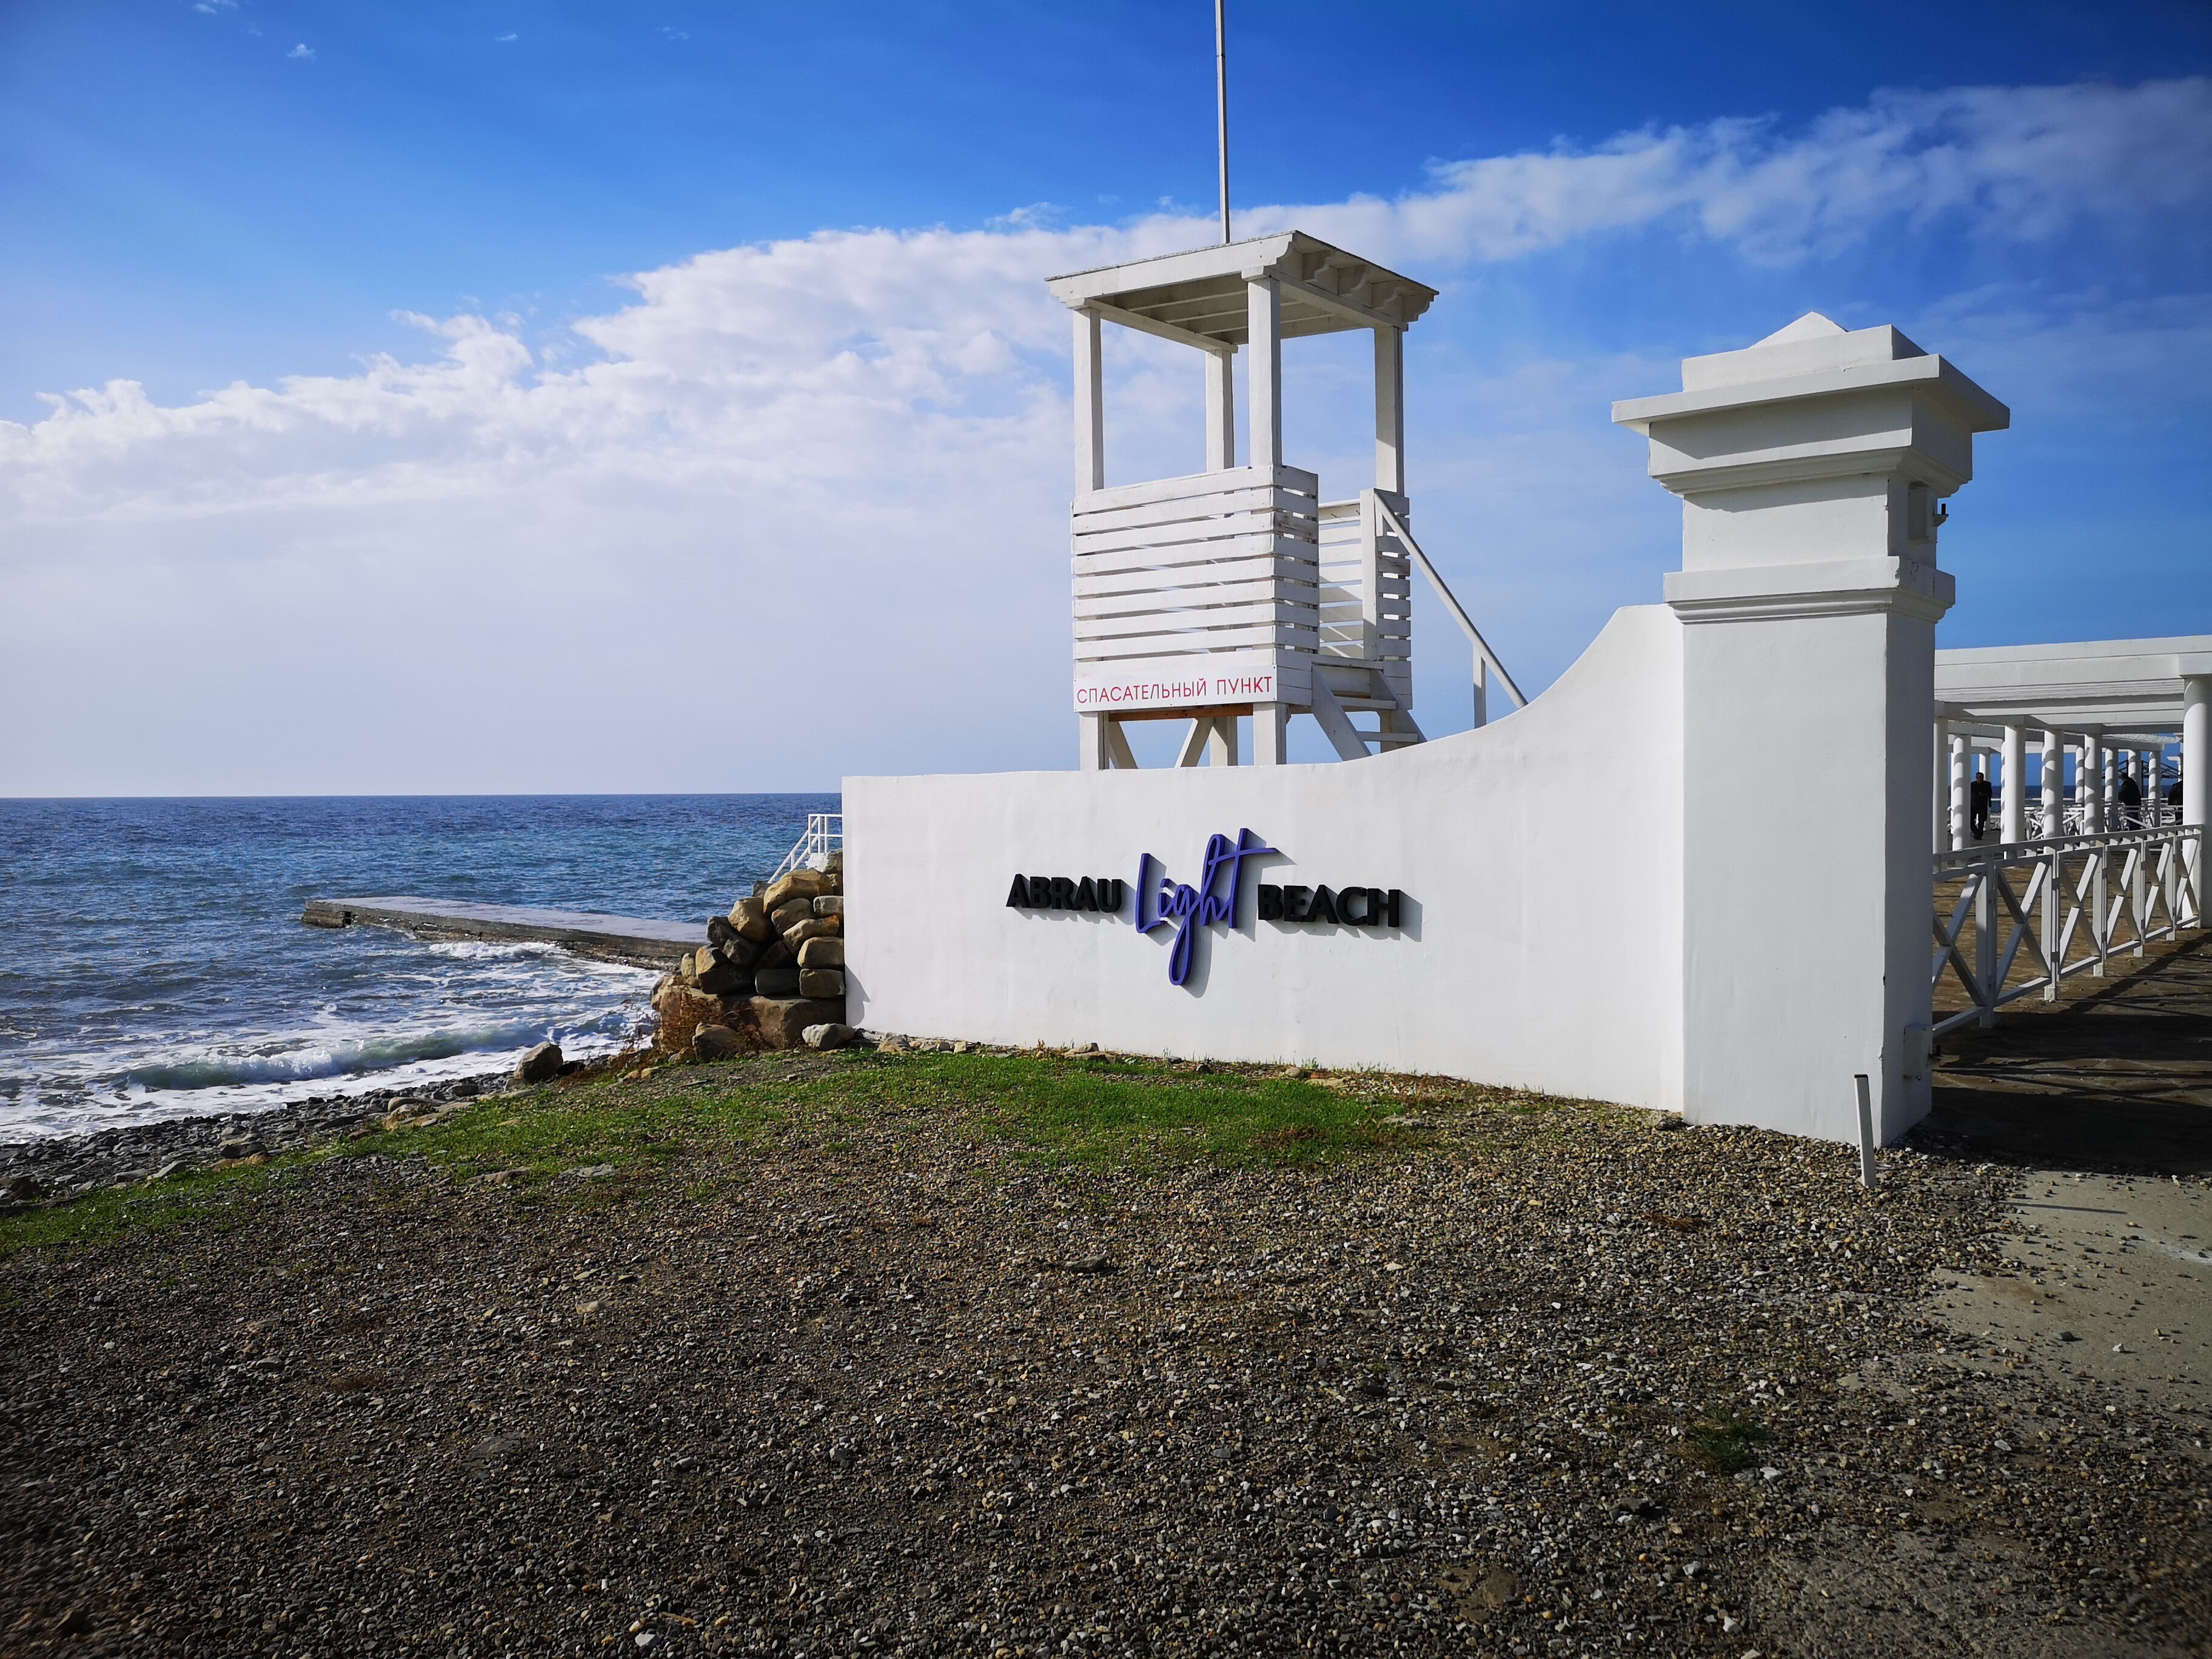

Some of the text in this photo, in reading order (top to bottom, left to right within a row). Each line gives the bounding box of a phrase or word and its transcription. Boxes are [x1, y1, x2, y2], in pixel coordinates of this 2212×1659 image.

[1077, 676, 1272, 703] СПАСАТЕЛЬНЫЙ ПУНКТ
[1005, 828, 1399, 986] ABRAU Light BEACH
